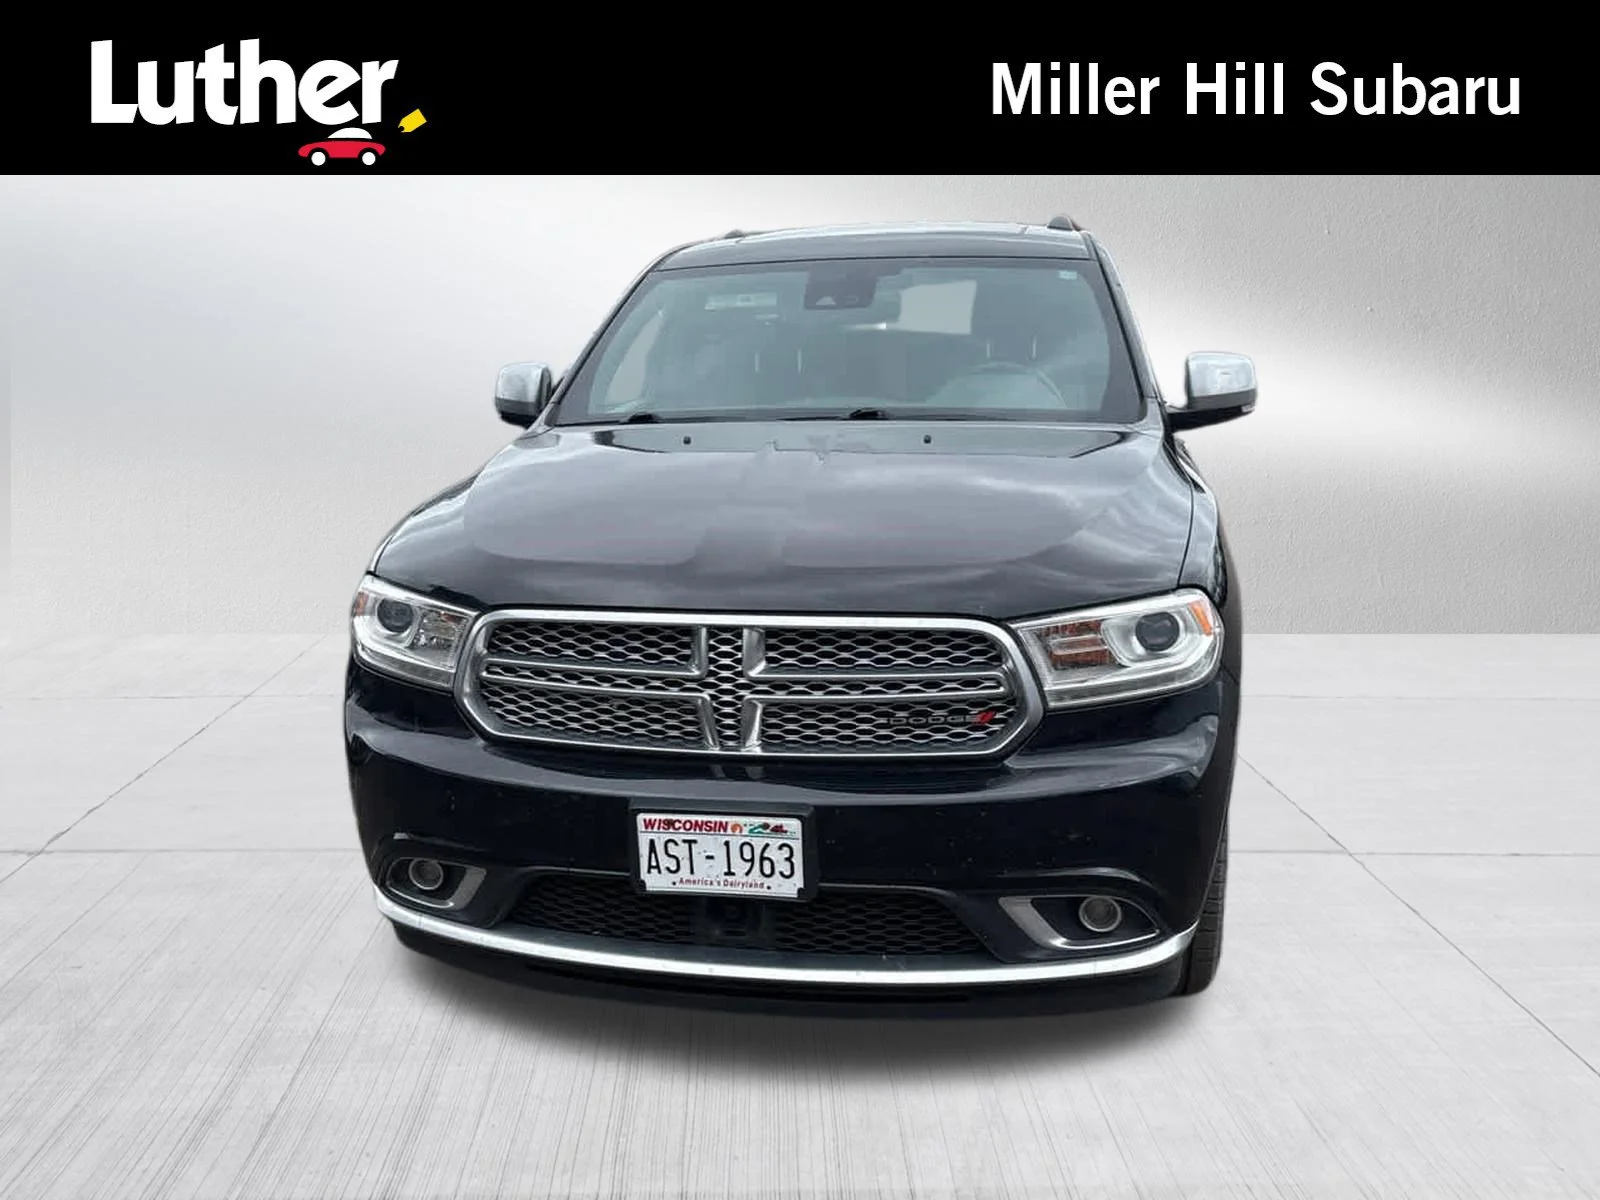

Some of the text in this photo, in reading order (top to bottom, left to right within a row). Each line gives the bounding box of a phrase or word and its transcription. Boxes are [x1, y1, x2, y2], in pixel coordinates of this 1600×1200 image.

[888, 715, 978, 725] DODGE
[643, 817, 728, 833] WISCONSIN
[647, 838, 795, 879] AST-1963
[678, 877, 764, 889] America's Dairyland
